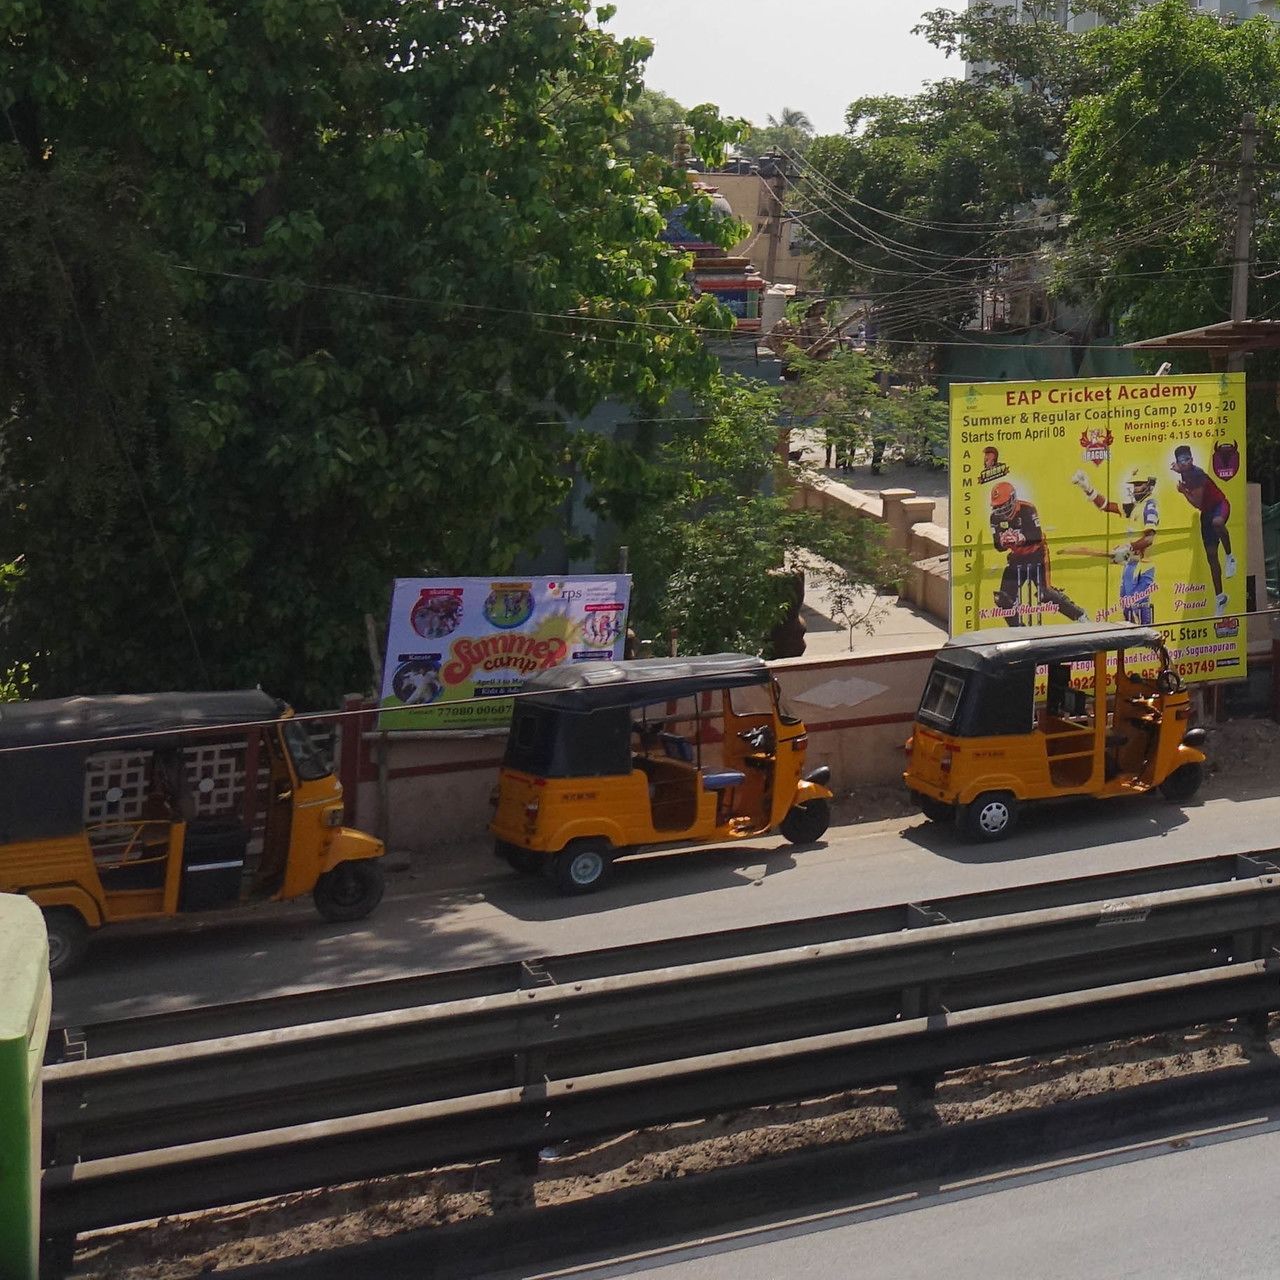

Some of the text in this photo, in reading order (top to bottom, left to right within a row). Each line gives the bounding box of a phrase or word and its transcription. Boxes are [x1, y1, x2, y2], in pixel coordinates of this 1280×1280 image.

[1006, 384, 1198, 407] EAP Cricket Academy
[963, 414, 1017, 427] Summer
[1020, 412, 1029, 424] &
[1032, 410, 1080, 425] Regular
[1084, 405, 1141, 422] Coaching
[1144, 404, 1177, 419] Camp
[1183, 402, 1212, 415] 2019
[1222, 400, 1236, 412] 20
[1124, 420, 1169, 432] Morning:
[1171, 418, 1193, 428] 6.15
[1195, 416, 1205, 426] to
[961, 426, 1066, 444] Starts from April 08
[1124, 432, 1167, 444] Evening:
[1169, 430, 1190, 440] 4.15
[1193, 429, 1203, 439] to
[561, 588, 582, 605] rps
[1174, 583, 1206, 595] Mohan
[964, 592, 973, 630] OPE
[1174, 597, 1208, 611] Prasad
[1179, 626, 1208, 642] Stars
[1185, 642, 1237, 659] Sugunapuram
[443, 633, 568, 687] Summer
[483, 655, 537, 674] camp
